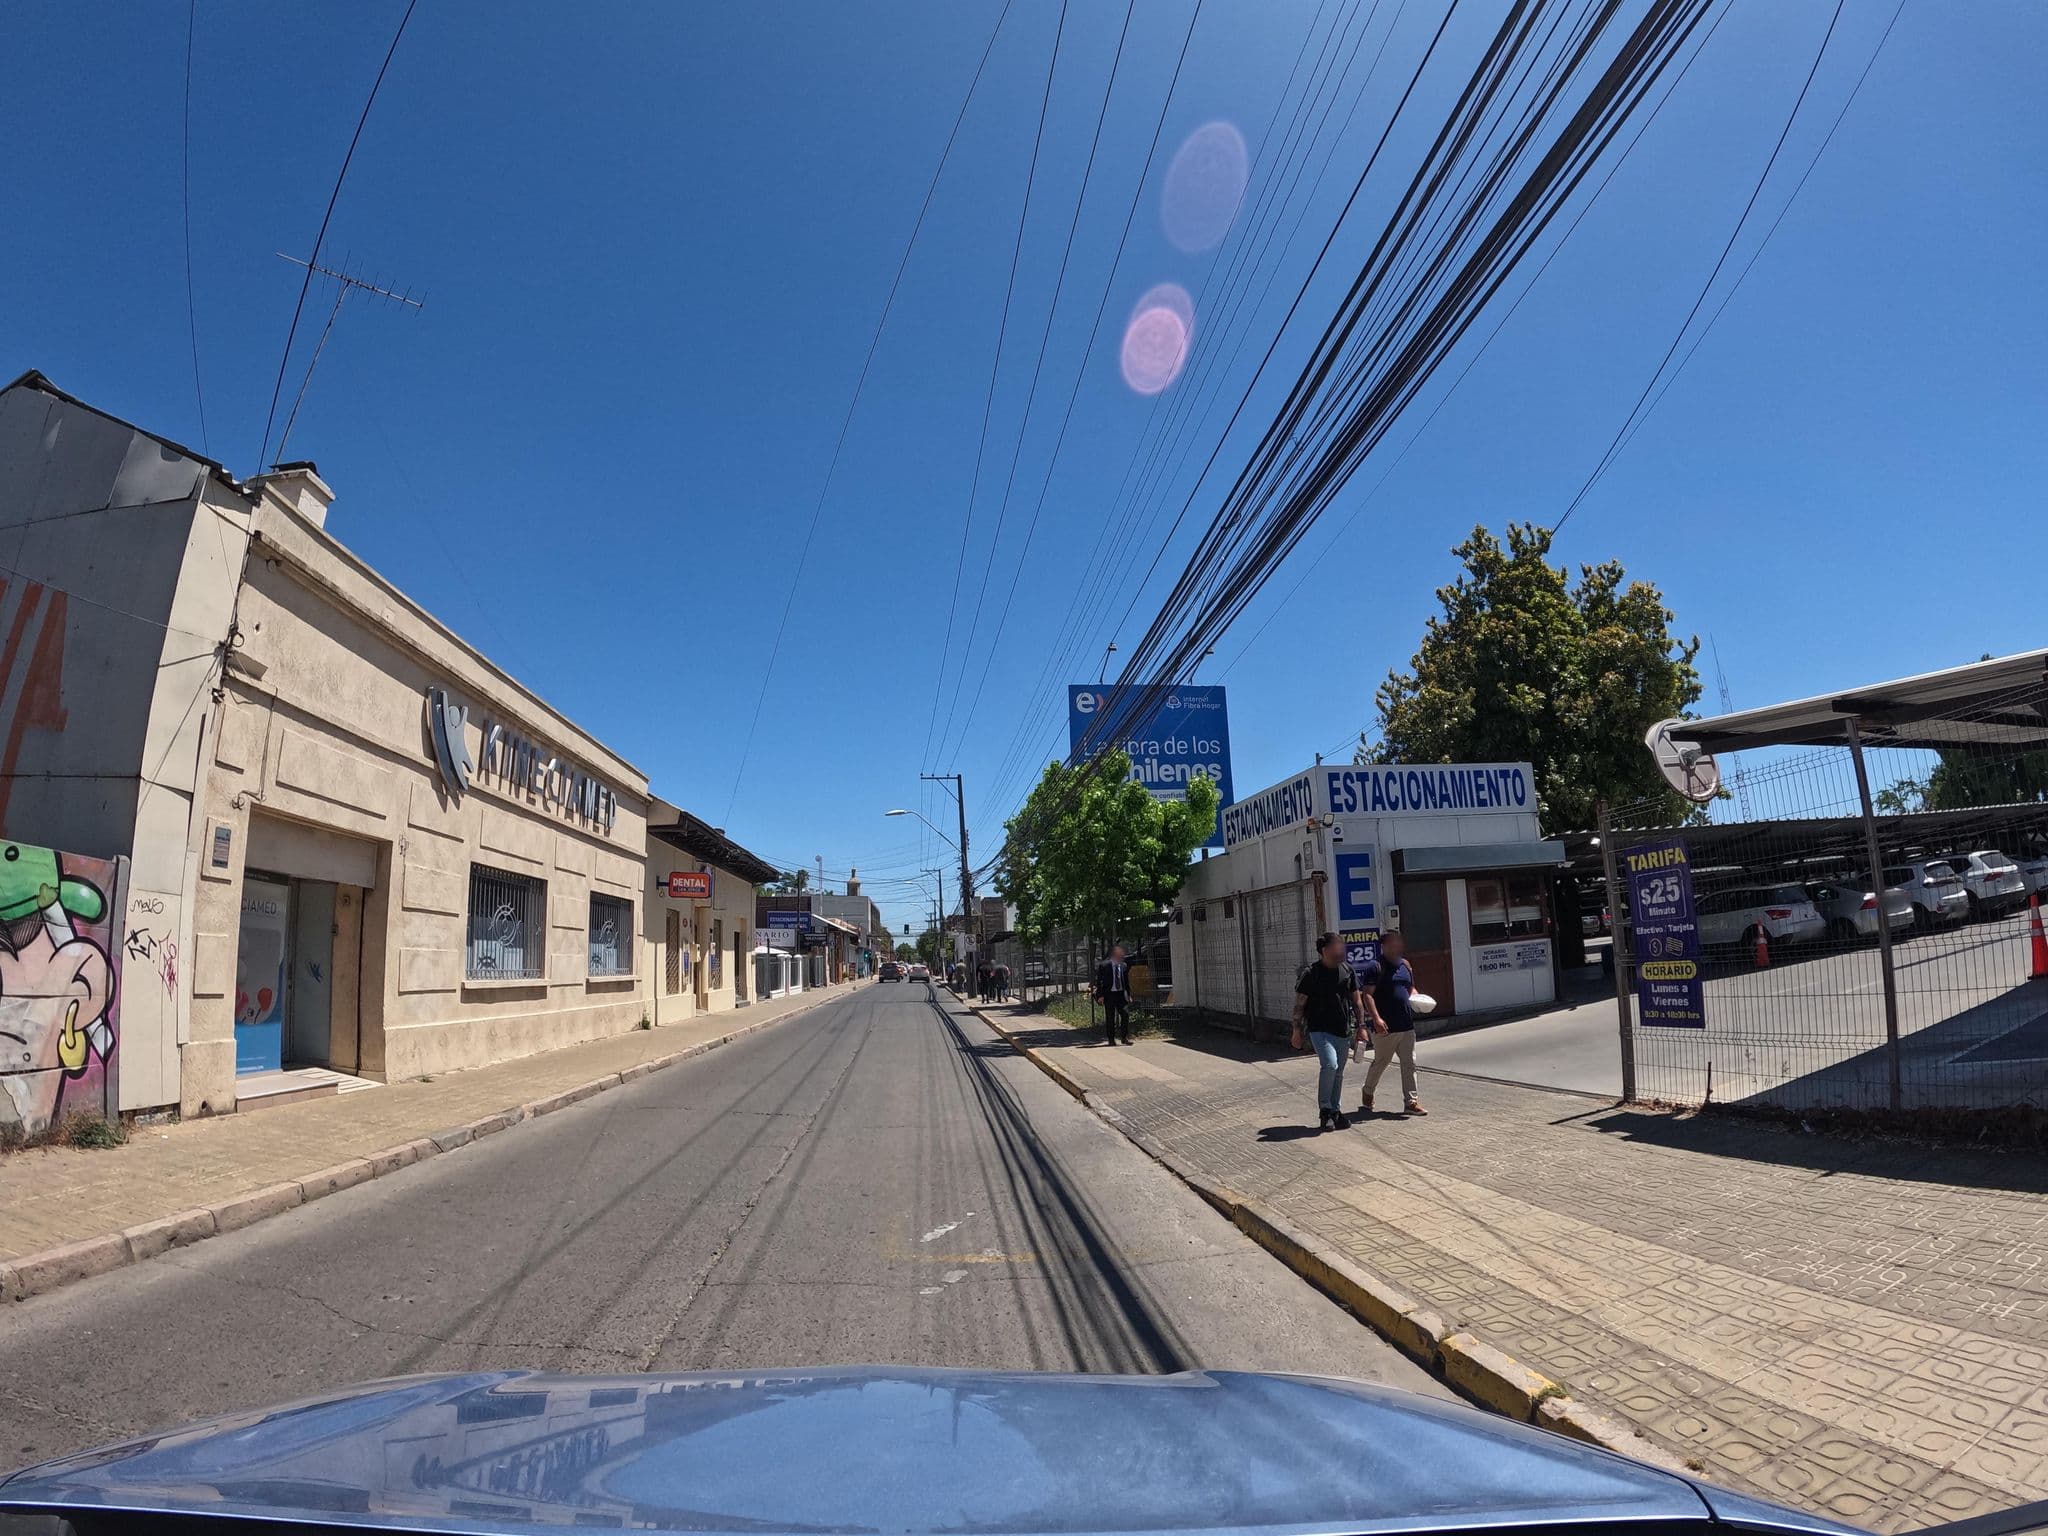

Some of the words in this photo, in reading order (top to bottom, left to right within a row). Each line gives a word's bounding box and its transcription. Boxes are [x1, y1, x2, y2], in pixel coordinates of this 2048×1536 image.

[1164, 736, 1188, 755] de
[1192, 735, 1221, 755] los
[1125, 758, 1223, 783] hilenos
[1327, 768, 1526, 813] ESTACIONAMIENTO
[1225, 776, 1313, 846] ESTACIONAMIENTO
[1627, 847, 1687, 872] TARIFA
[672, 877, 706, 888] DENTAL
[1335, 853, 1375, 921] E
[1640, 876, 1681, 906] $25
[1648, 907, 1677, 917] Minuto
[1667, 923, 1695, 934] Tarjeta
[1342, 931, 1379, 943] TARIFA
[1347, 946, 1375, 962] $25
[1645, 965, 1693, 977] HORARIO
[1651, 983, 1680, 993] Lunes
[1681, 984, 1689, 993] a
[1652, 996, 1690, 1006] Viernes
